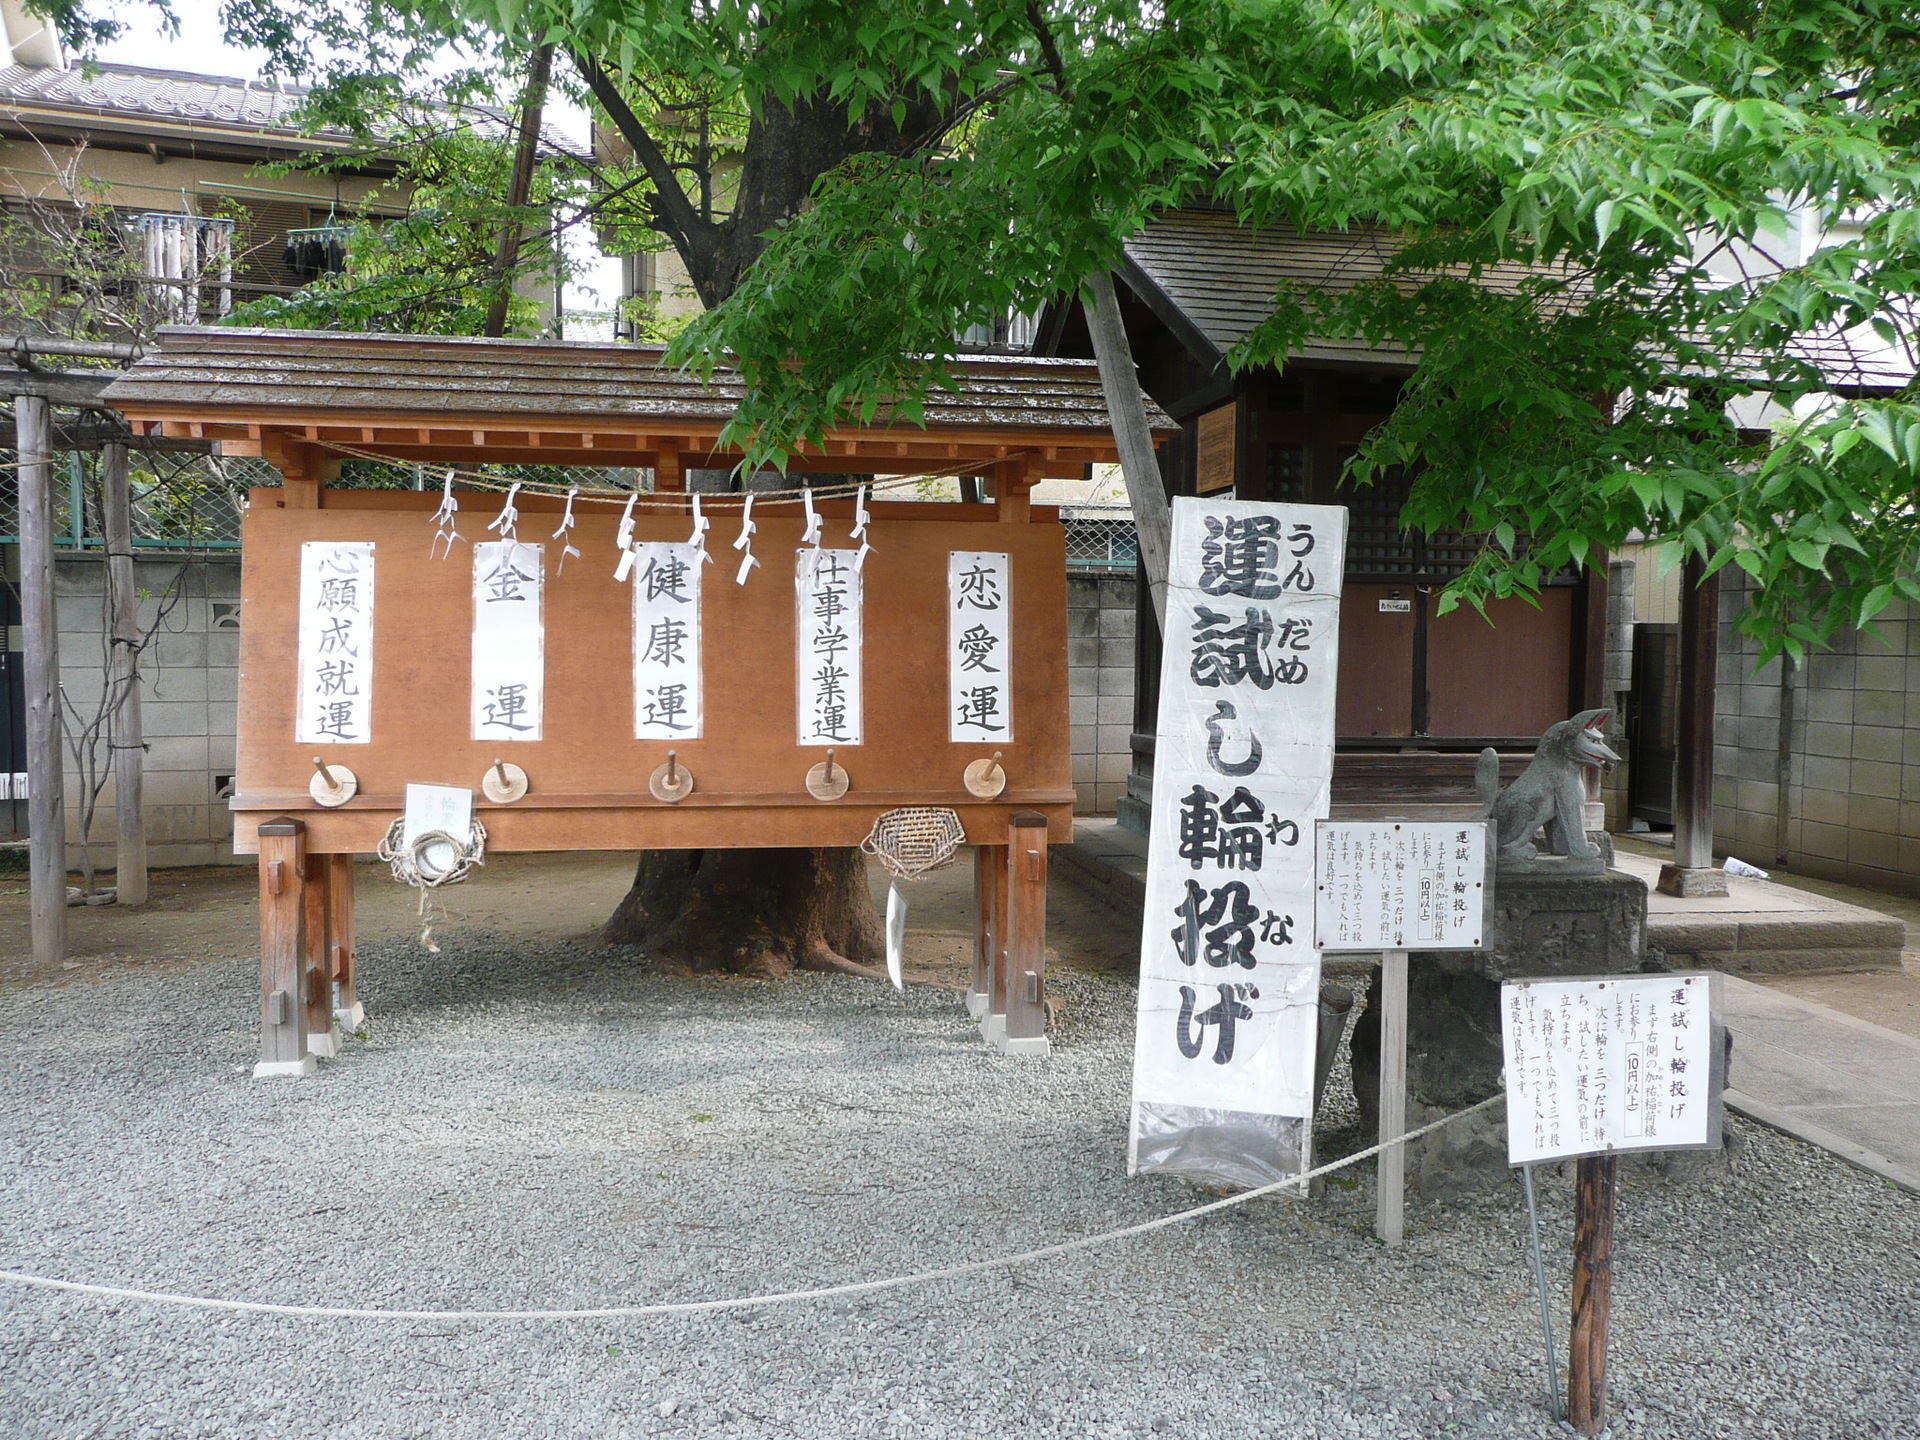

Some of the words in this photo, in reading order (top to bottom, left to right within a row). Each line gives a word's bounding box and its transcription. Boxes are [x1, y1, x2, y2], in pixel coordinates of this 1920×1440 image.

[1282, 523, 1315, 593] うん
[315, 550, 361, 740] 心願成就運
[640, 557, 693, 731] 健康運
[811, 555, 851, 743] 仕事学業運
[956, 564, 1005, 732] 恋愛運
[1274, 617, 1313, 685] だめ
[1171, 514, 1282, 1066] 運試し輪投げ
[1265, 813, 1299, 846] わ
[1422, 832, 1432, 868] にお参り
[1452, 830, 1469, 928] 運試し輪投げ
[1260, 910, 1294, 946] な
[1509, 996, 1529, 1099] 運気は良好です。
[1559, 993, 1573, 1053] 立ちます。
[1614, 993, 1625, 1033] します。
[1629, 993, 1642, 1040] にお参り
[1626, 1052, 1639, 1112] (10円以上)
[1669, 987, 1688, 1120] 運試し輪投げ
